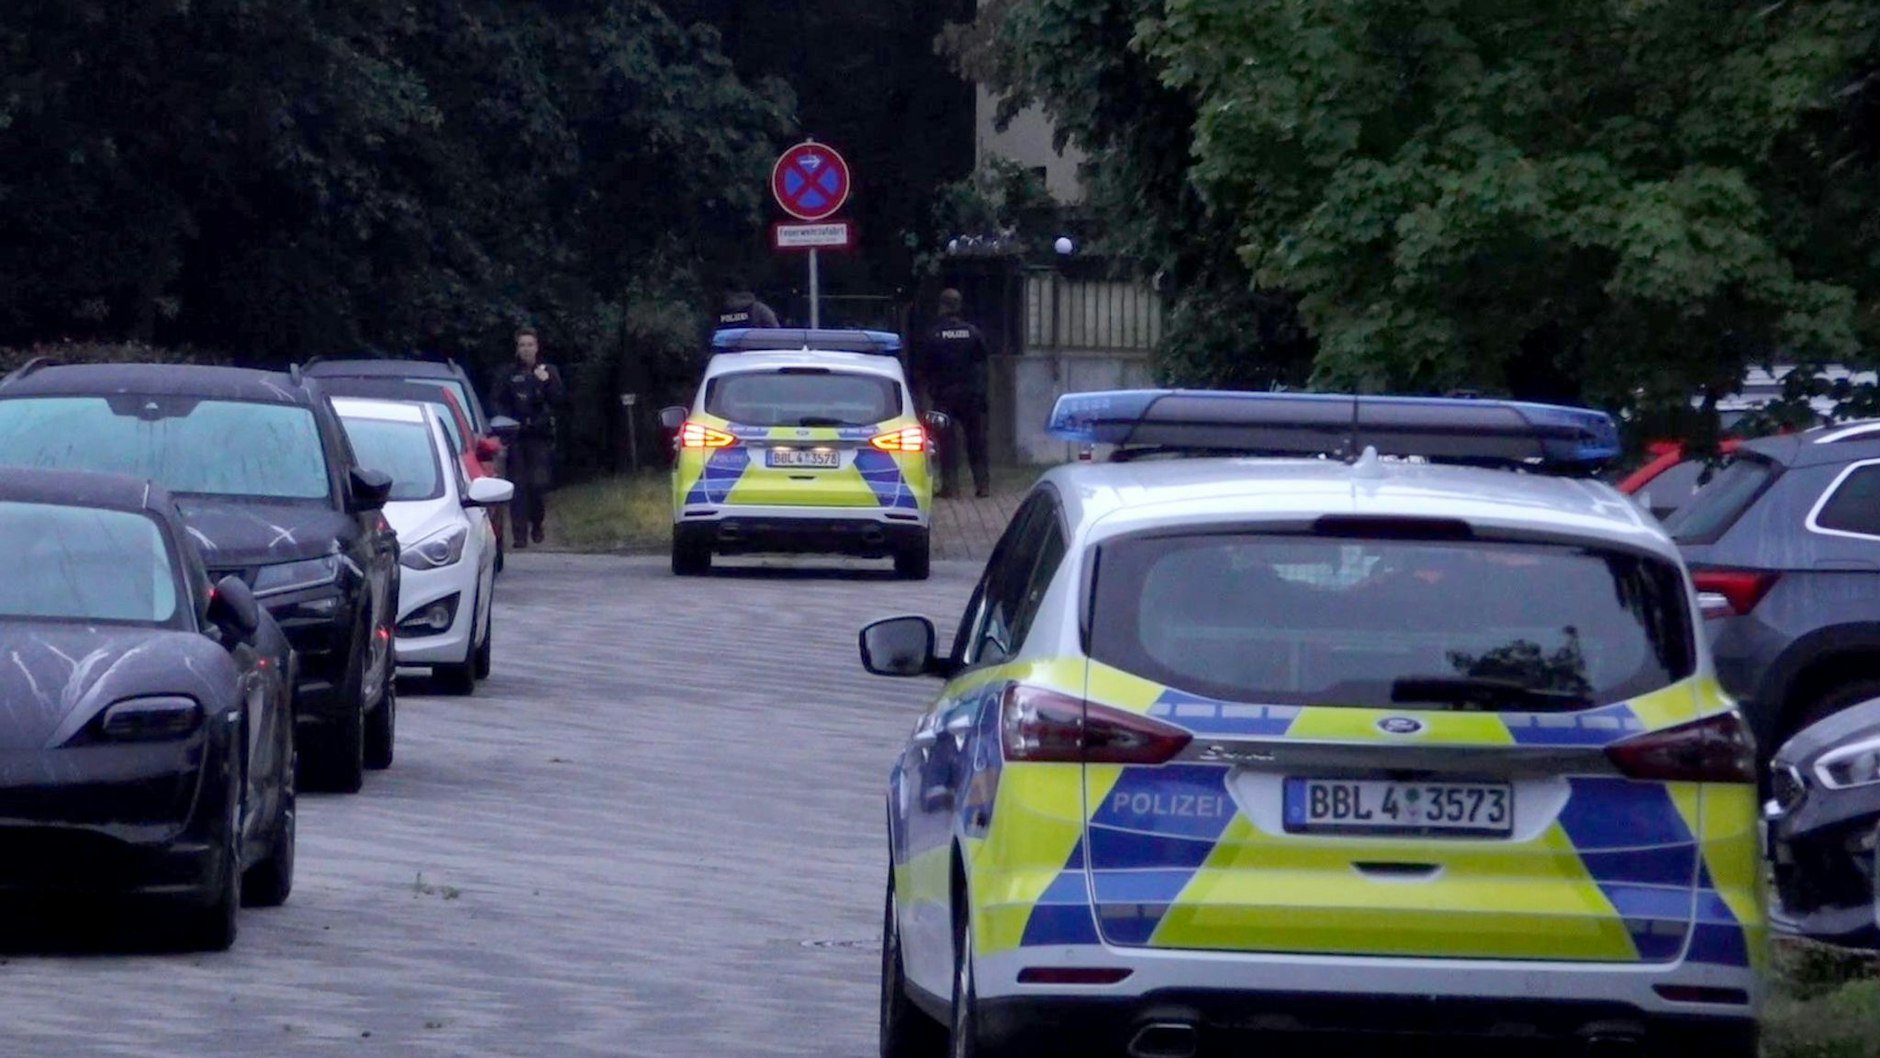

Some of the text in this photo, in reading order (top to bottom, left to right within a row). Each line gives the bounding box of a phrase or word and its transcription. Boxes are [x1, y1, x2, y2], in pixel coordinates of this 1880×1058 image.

[942, 330, 970, 339] POLIZEI
[1112, 791, 1223, 817] POLIZEI
[1310, 784, 1505, 823] BBL 4 3573
